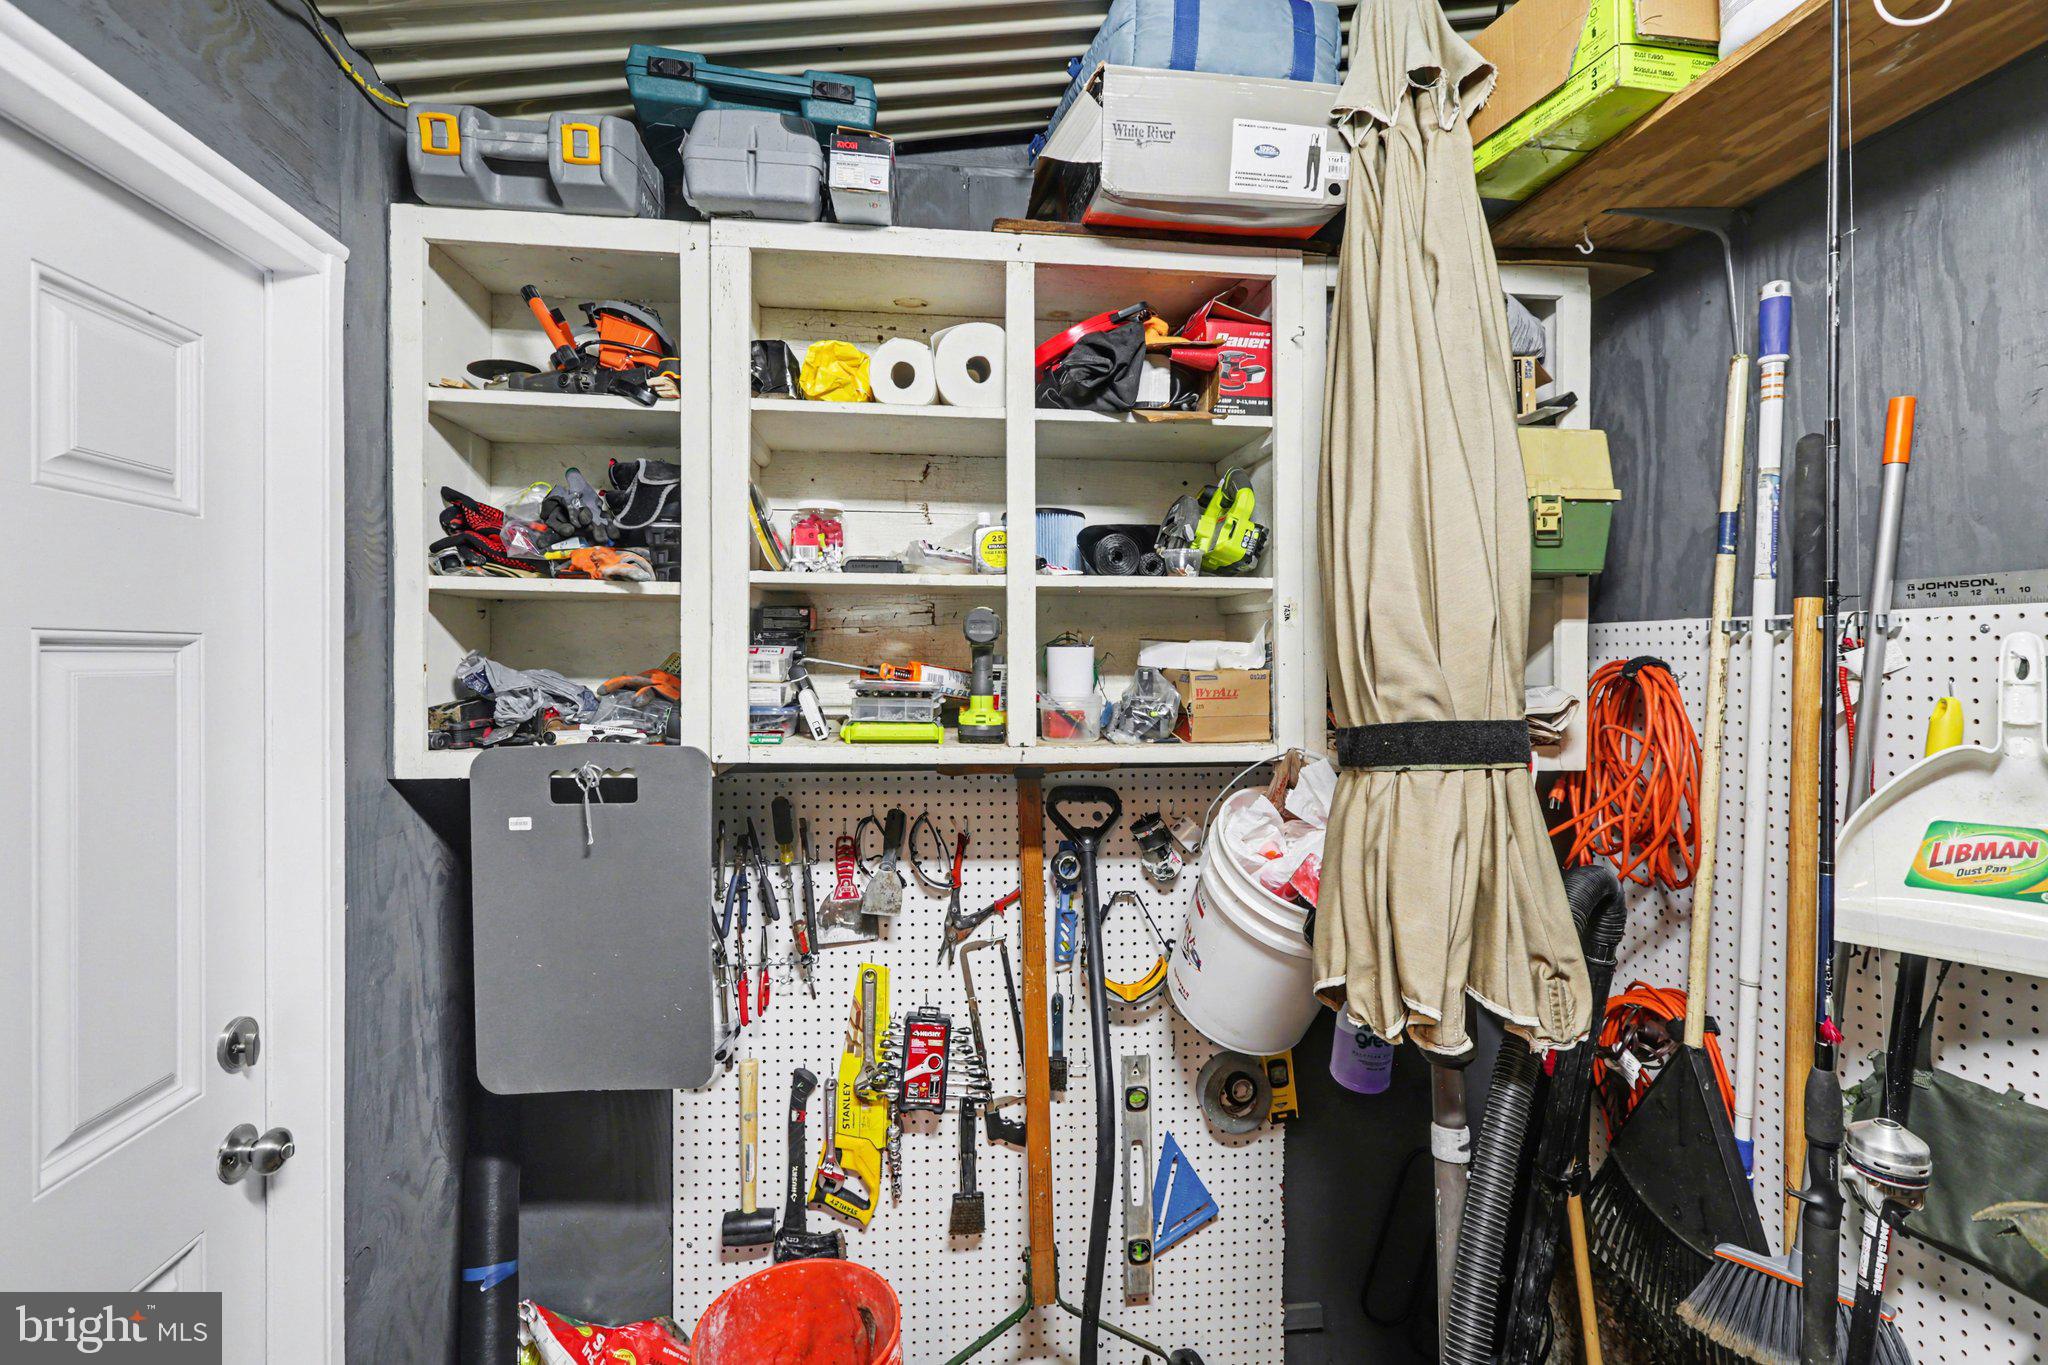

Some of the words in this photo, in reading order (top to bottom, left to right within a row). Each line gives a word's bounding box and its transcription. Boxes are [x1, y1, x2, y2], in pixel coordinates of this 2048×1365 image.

[1112, 122, 1145, 138] White
[1147, 125, 1176, 140] River
[1928, 841, 2039, 869] LIBMAN
[1956, 867, 1982, 877] Dust
[1985, 865, 2008, 874] Pan
[842, 1083, 851, 1130] STANLEY
[791, 1165, 799, 1192] HUSKY
[829, 1198, 858, 1216] STANLEY
